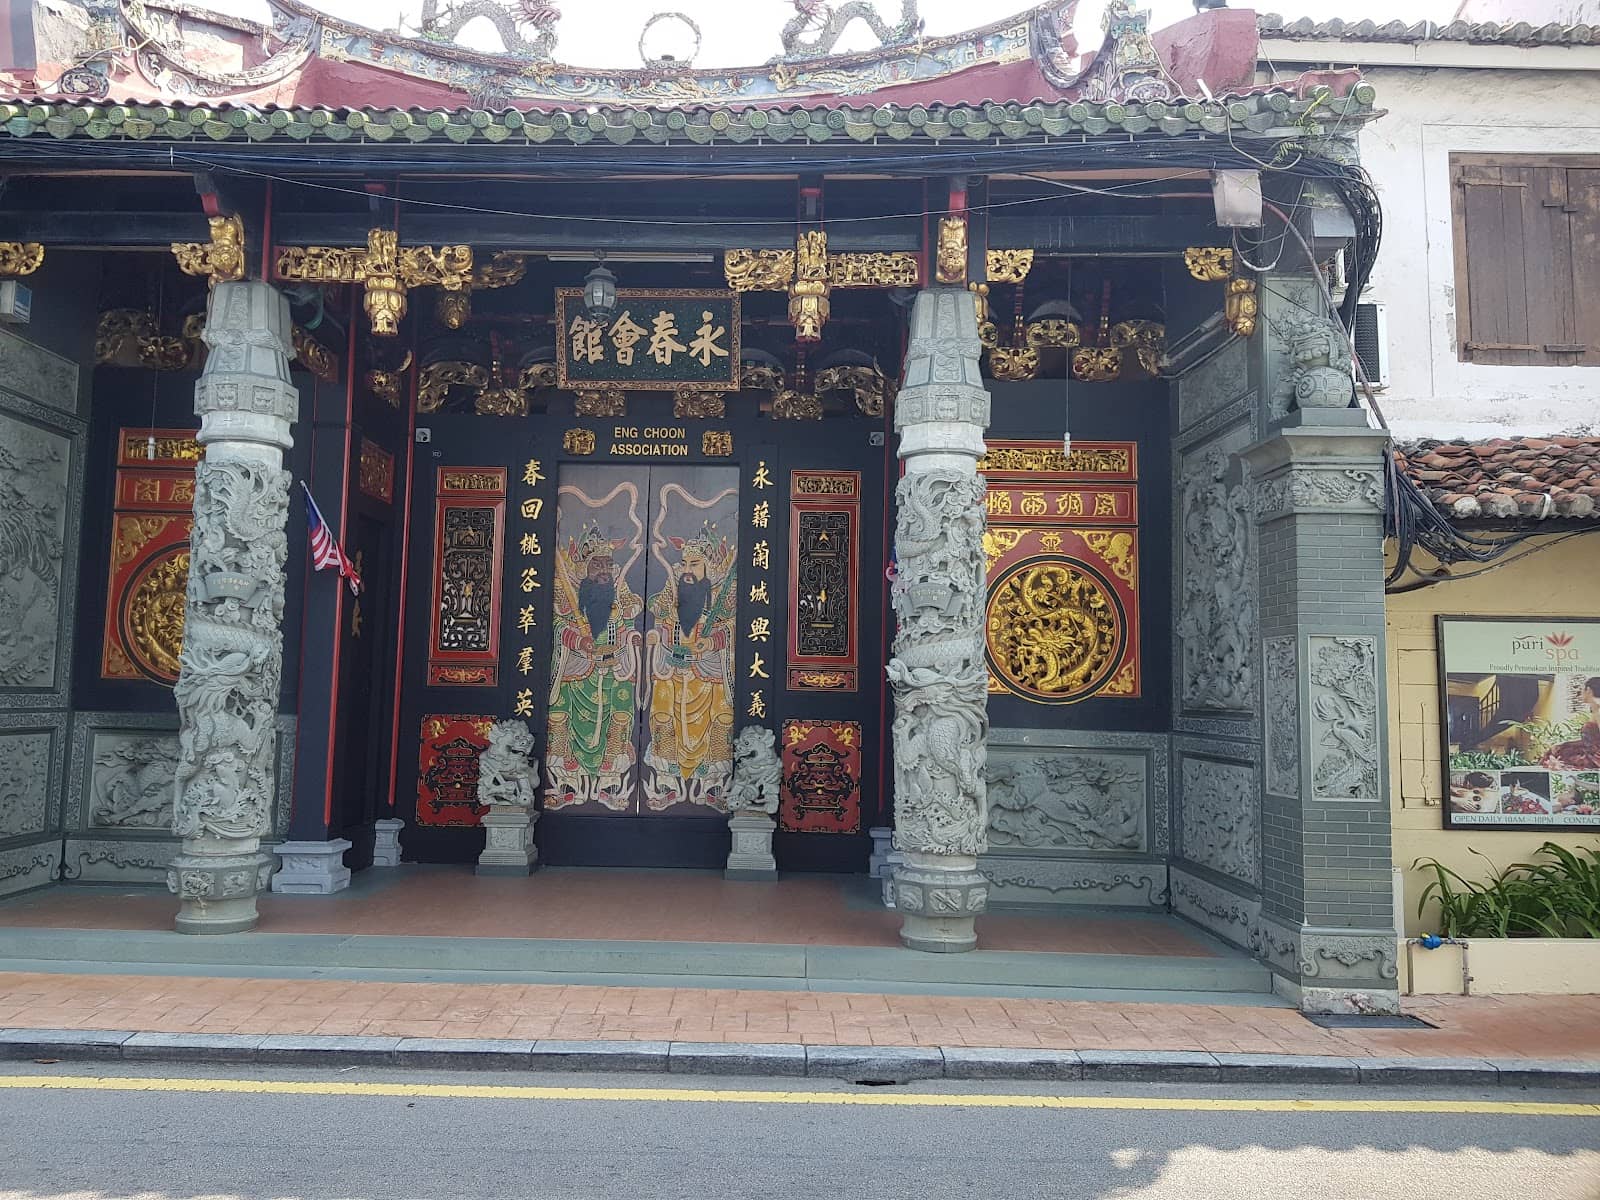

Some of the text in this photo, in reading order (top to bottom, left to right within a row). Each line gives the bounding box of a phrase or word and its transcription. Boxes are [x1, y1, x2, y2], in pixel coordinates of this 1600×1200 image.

[614, 427, 686, 439] ENG CHOON
[609, 443, 688, 456] ASSOCIATION
[1546, 648, 1579, 666] spa
[1489, 663, 1513, 673] Proudly
[1454, 815, 1477, 823] OPEN
[1478, 815, 1502, 823] DAILY
